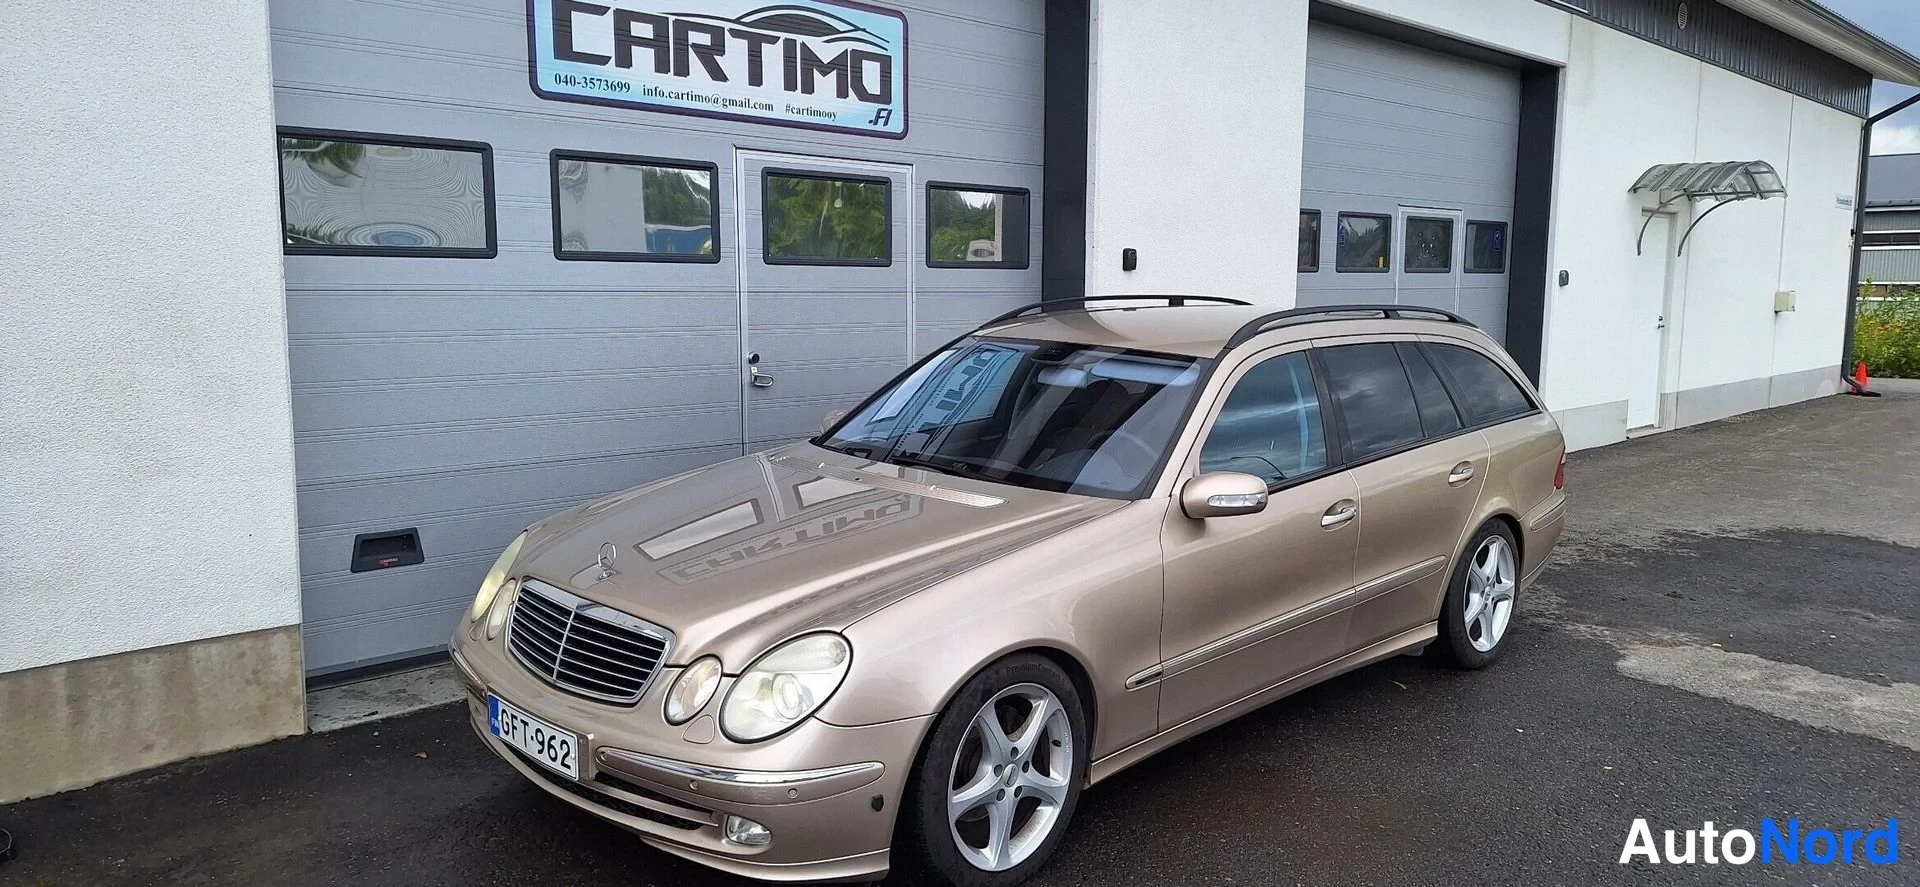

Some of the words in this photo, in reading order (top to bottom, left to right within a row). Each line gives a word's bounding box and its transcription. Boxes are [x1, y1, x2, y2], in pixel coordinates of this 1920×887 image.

[551, 0, 892, 105] CARTIMO
[554, 73, 631, 93] 040-3573699
[643, 84, 774, 112] info.cartimo@gmail.com
[785, 104, 837, 121] #cartimooy
[501, 708, 571, 770] GFT-962
